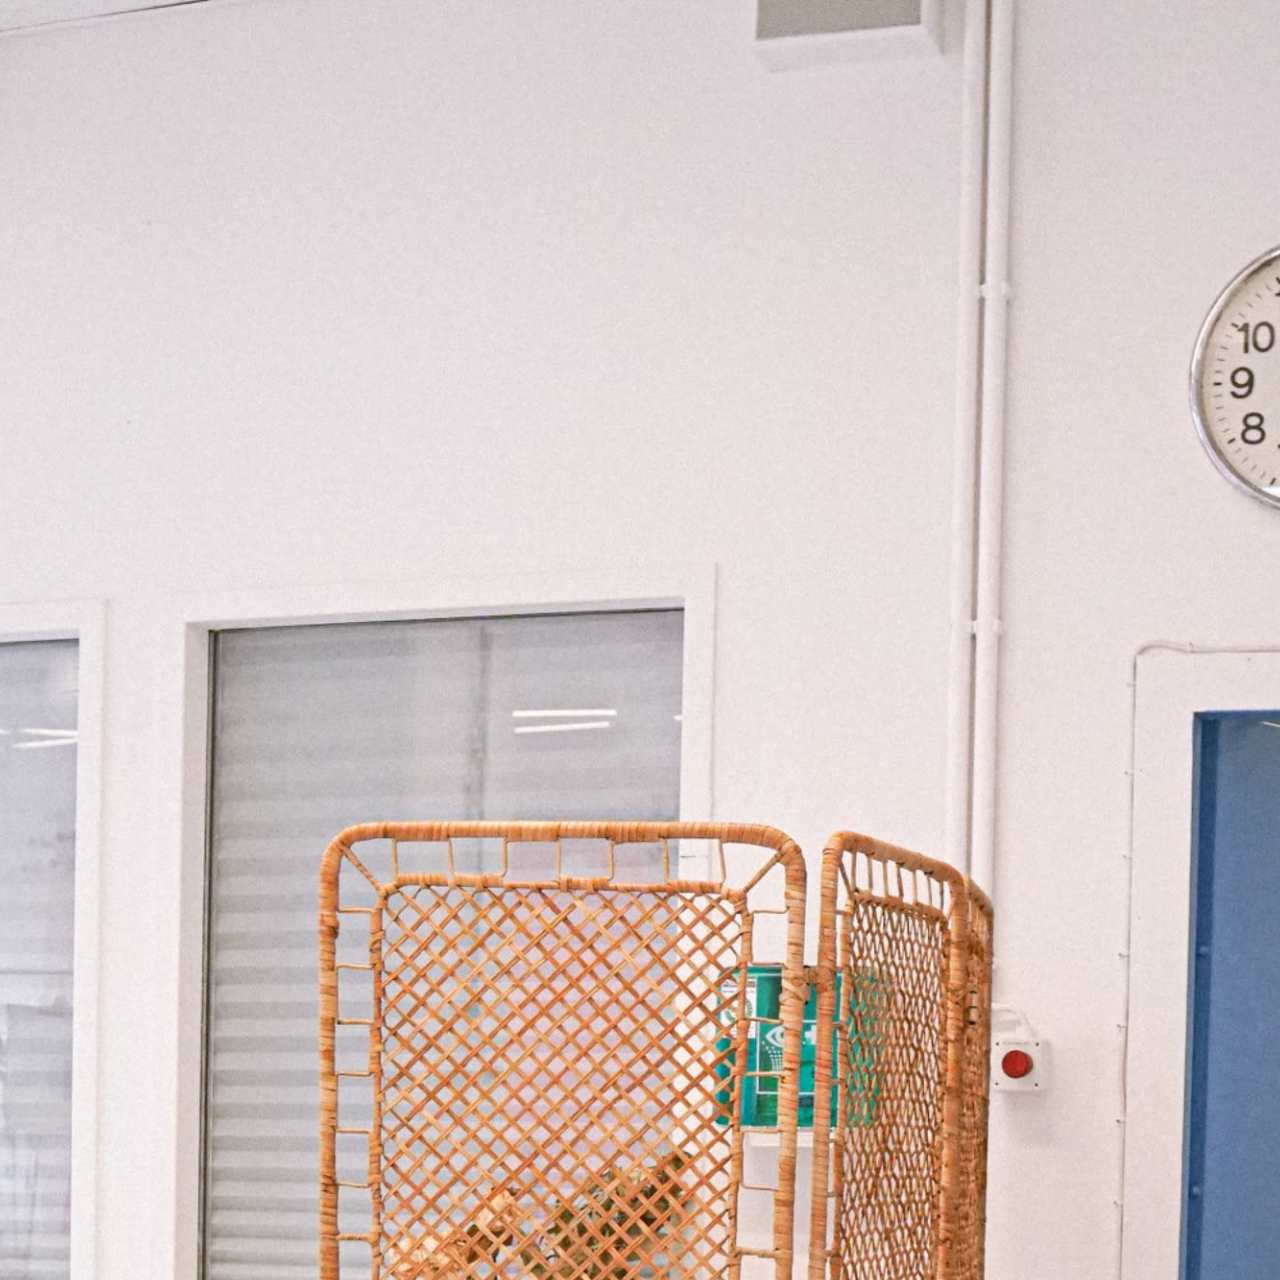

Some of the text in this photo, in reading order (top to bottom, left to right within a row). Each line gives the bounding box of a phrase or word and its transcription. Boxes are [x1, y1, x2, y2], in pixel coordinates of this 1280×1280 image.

[1237, 321, 1275, 353] 10
[1229, 366, 1255, 399] 9
[1241, 412, 1266, 445] 8
